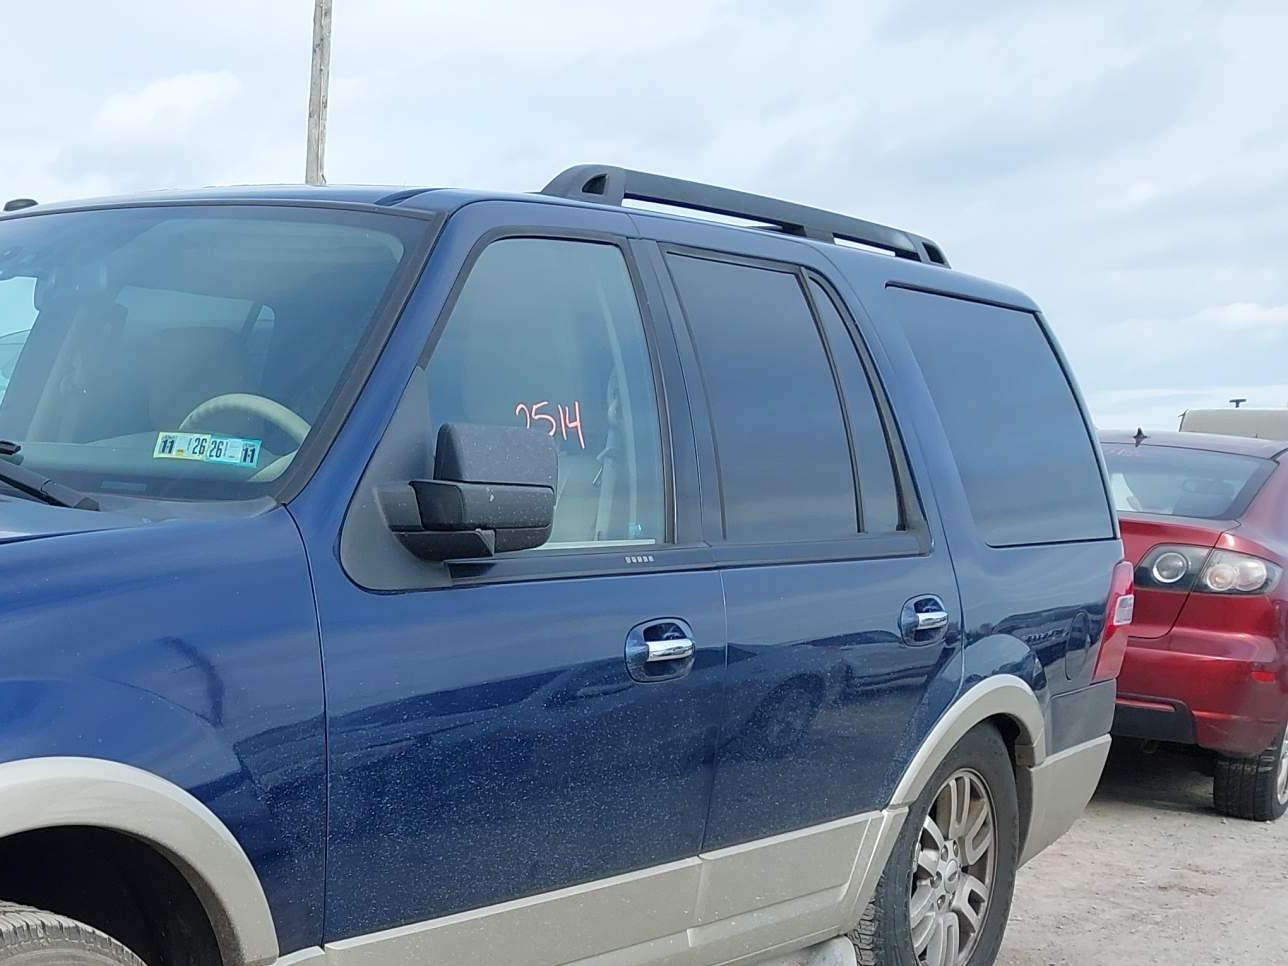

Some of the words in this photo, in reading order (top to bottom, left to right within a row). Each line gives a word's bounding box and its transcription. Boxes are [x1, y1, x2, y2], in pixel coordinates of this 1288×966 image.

[515, 401, 585, 449] 2514
[192, 438, 208, 455] 26
[209, 440, 224, 458] 26
